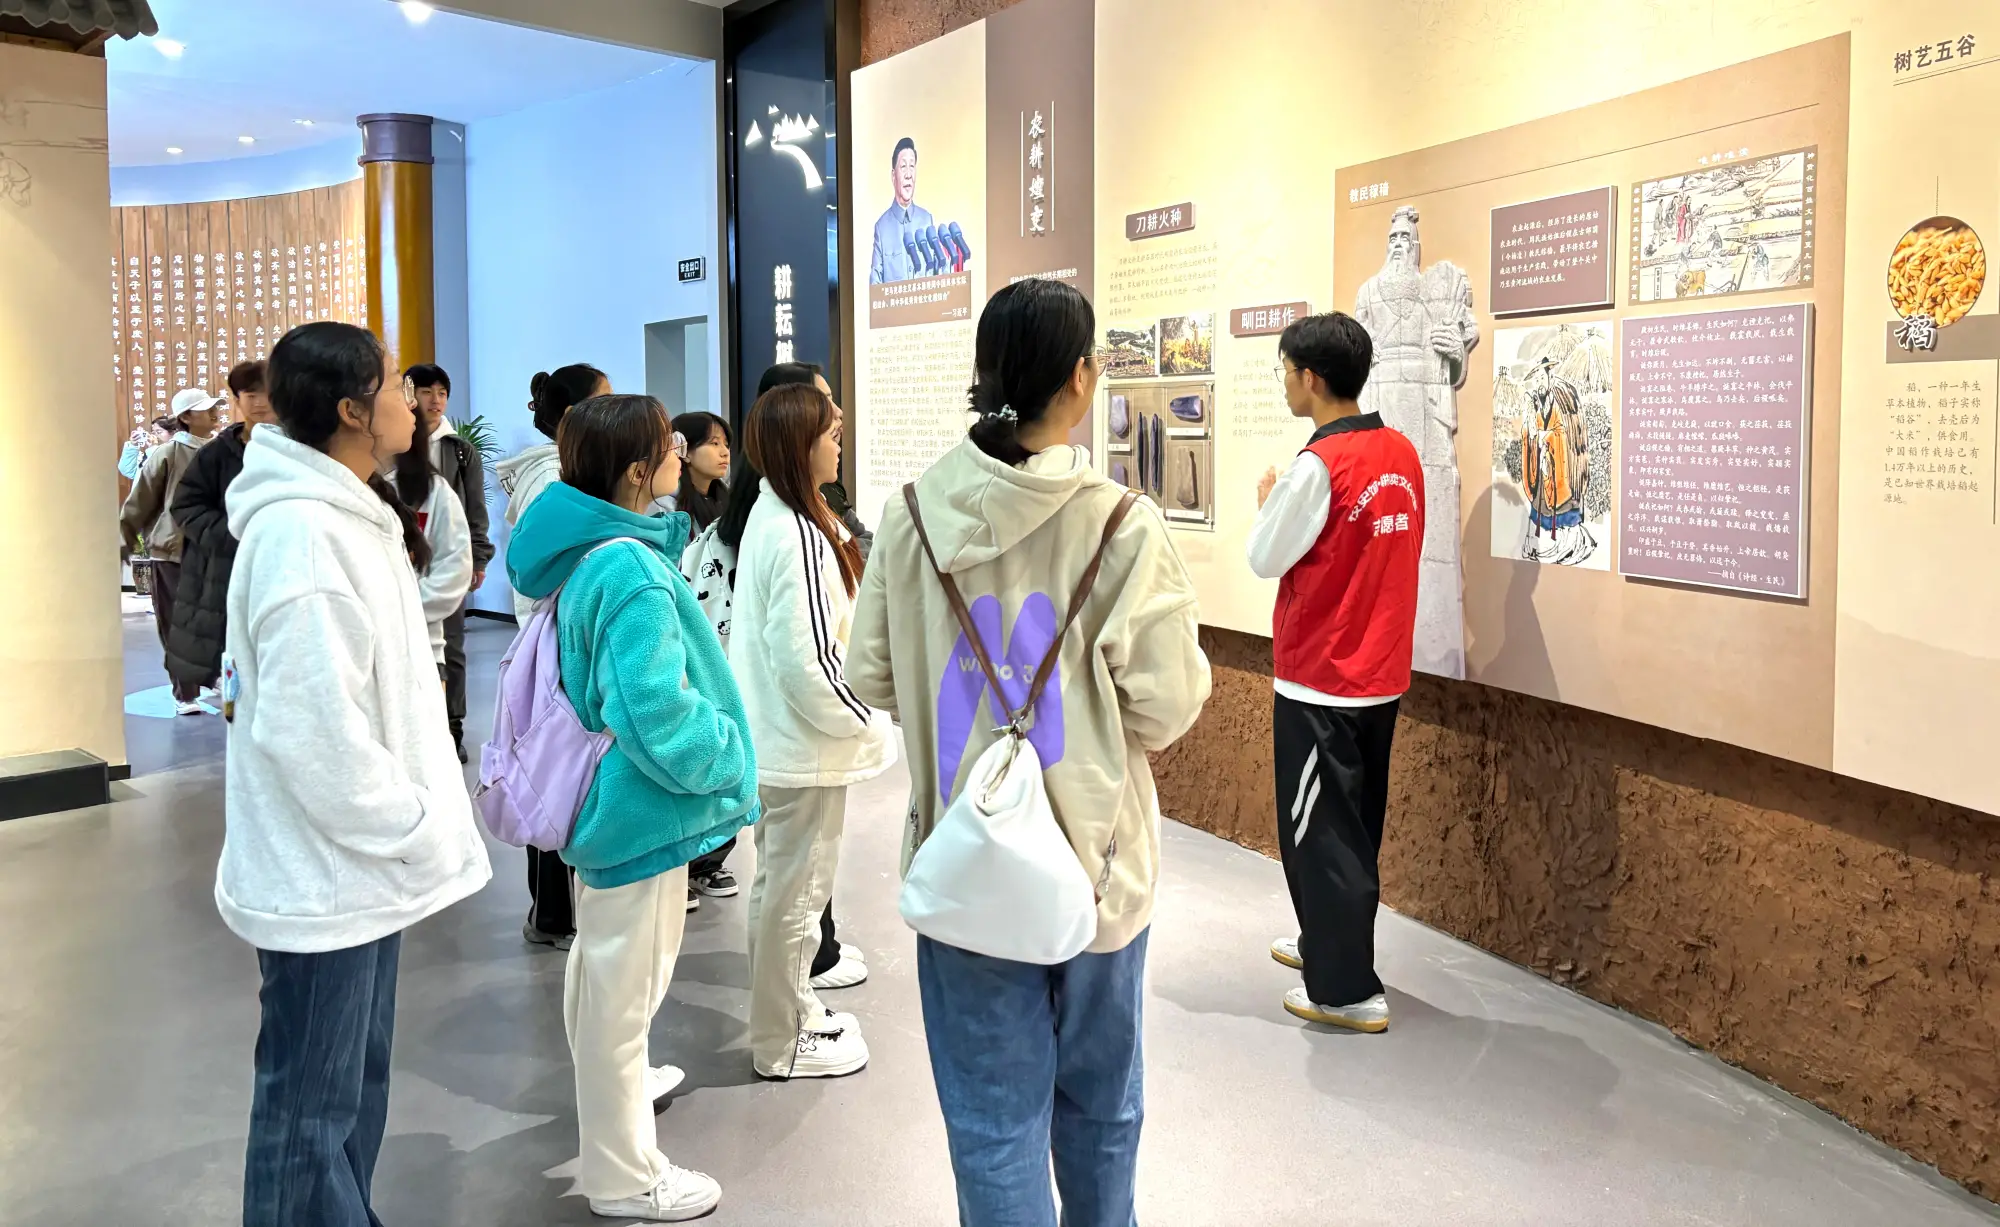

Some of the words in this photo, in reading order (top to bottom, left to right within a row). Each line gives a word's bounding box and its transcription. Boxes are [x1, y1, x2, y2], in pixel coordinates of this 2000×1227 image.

[1893, 33, 1976, 74] 树艺五谷
[1135, 207, 1182, 234] 刀耕火种
[680, 260, 699, 273] 安全出口
[1894, 313, 1937, 349] 稻
[1885, 445, 1980, 459] 中国稻作栽培已有
[1883, 477, 1979, 493] 是已知世界栽培稻起
